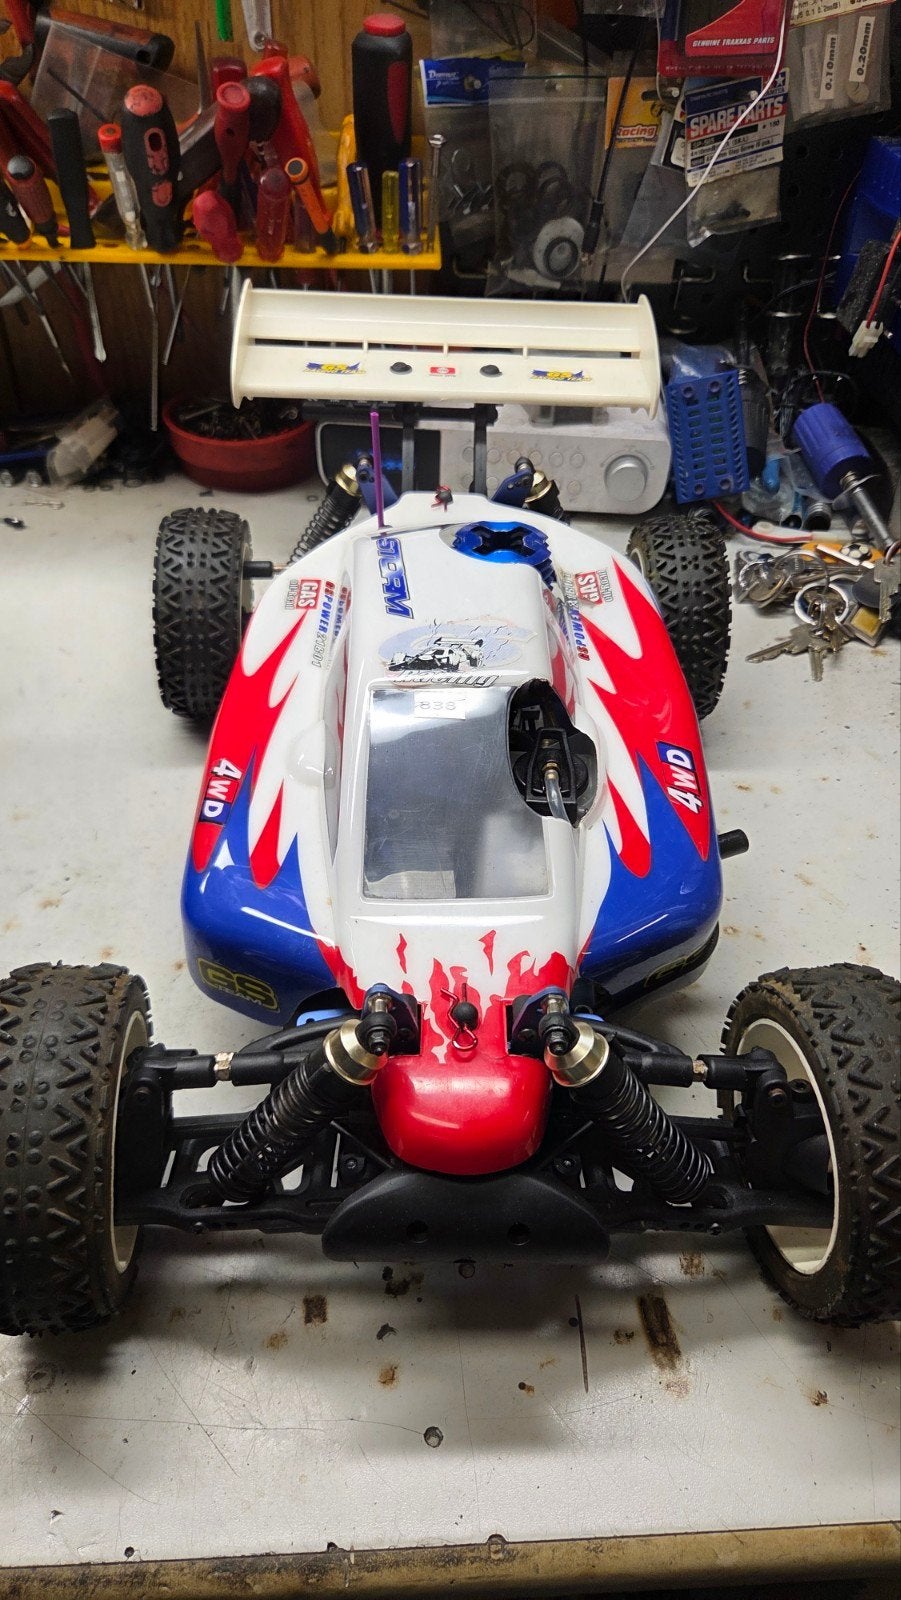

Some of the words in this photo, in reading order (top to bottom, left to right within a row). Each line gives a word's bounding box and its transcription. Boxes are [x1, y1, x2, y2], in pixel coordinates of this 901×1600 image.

[693, 39, 720, 47] GENUINE
[722, 38, 752, 46] TRAXXAS
[753, 36, 776, 44] PARTS
[825, 37, 836, 91] 0.10mm
[856, 22, 871, 76] 0.20mm
[690, 108, 735, 138] SPARE
[737, 96, 783, 125] PARTS
[297, 582, 319, 609] GAS
[377, 537, 414, 620] STORM
[578, 574, 600, 603] GAS
[203, 758, 243, 818] 4WD
[666, 749, 702, 814] 4WD
